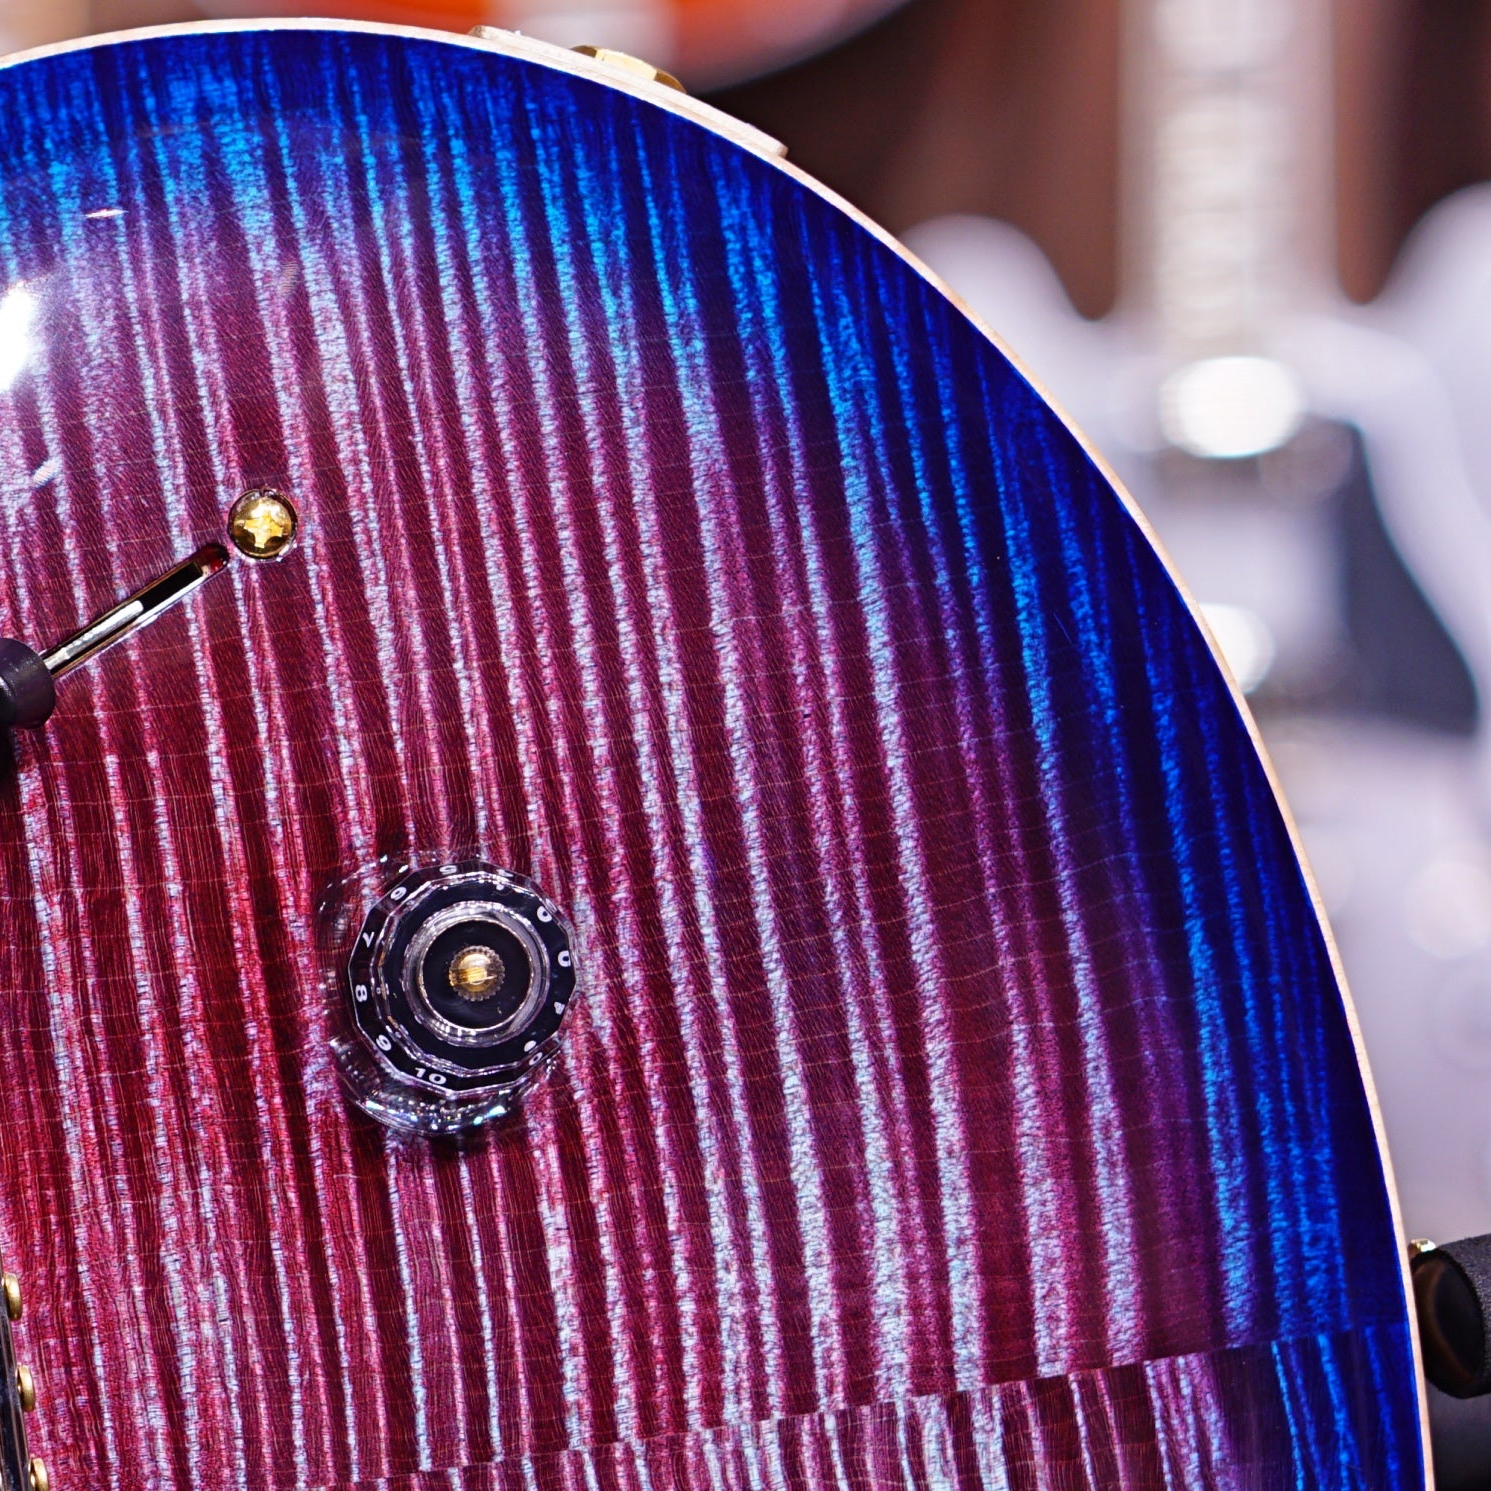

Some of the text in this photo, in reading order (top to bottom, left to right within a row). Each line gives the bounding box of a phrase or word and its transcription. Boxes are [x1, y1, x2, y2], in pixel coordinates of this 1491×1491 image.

[391, 887, 407, 900] 6
[363, 932, 375, 948] 7
[355, 984, 368, 1002] 8
[376, 1034, 392, 1051] 9
[529, 1052, 543, 1066] 0
[415, 1067, 447, 1085] 10
